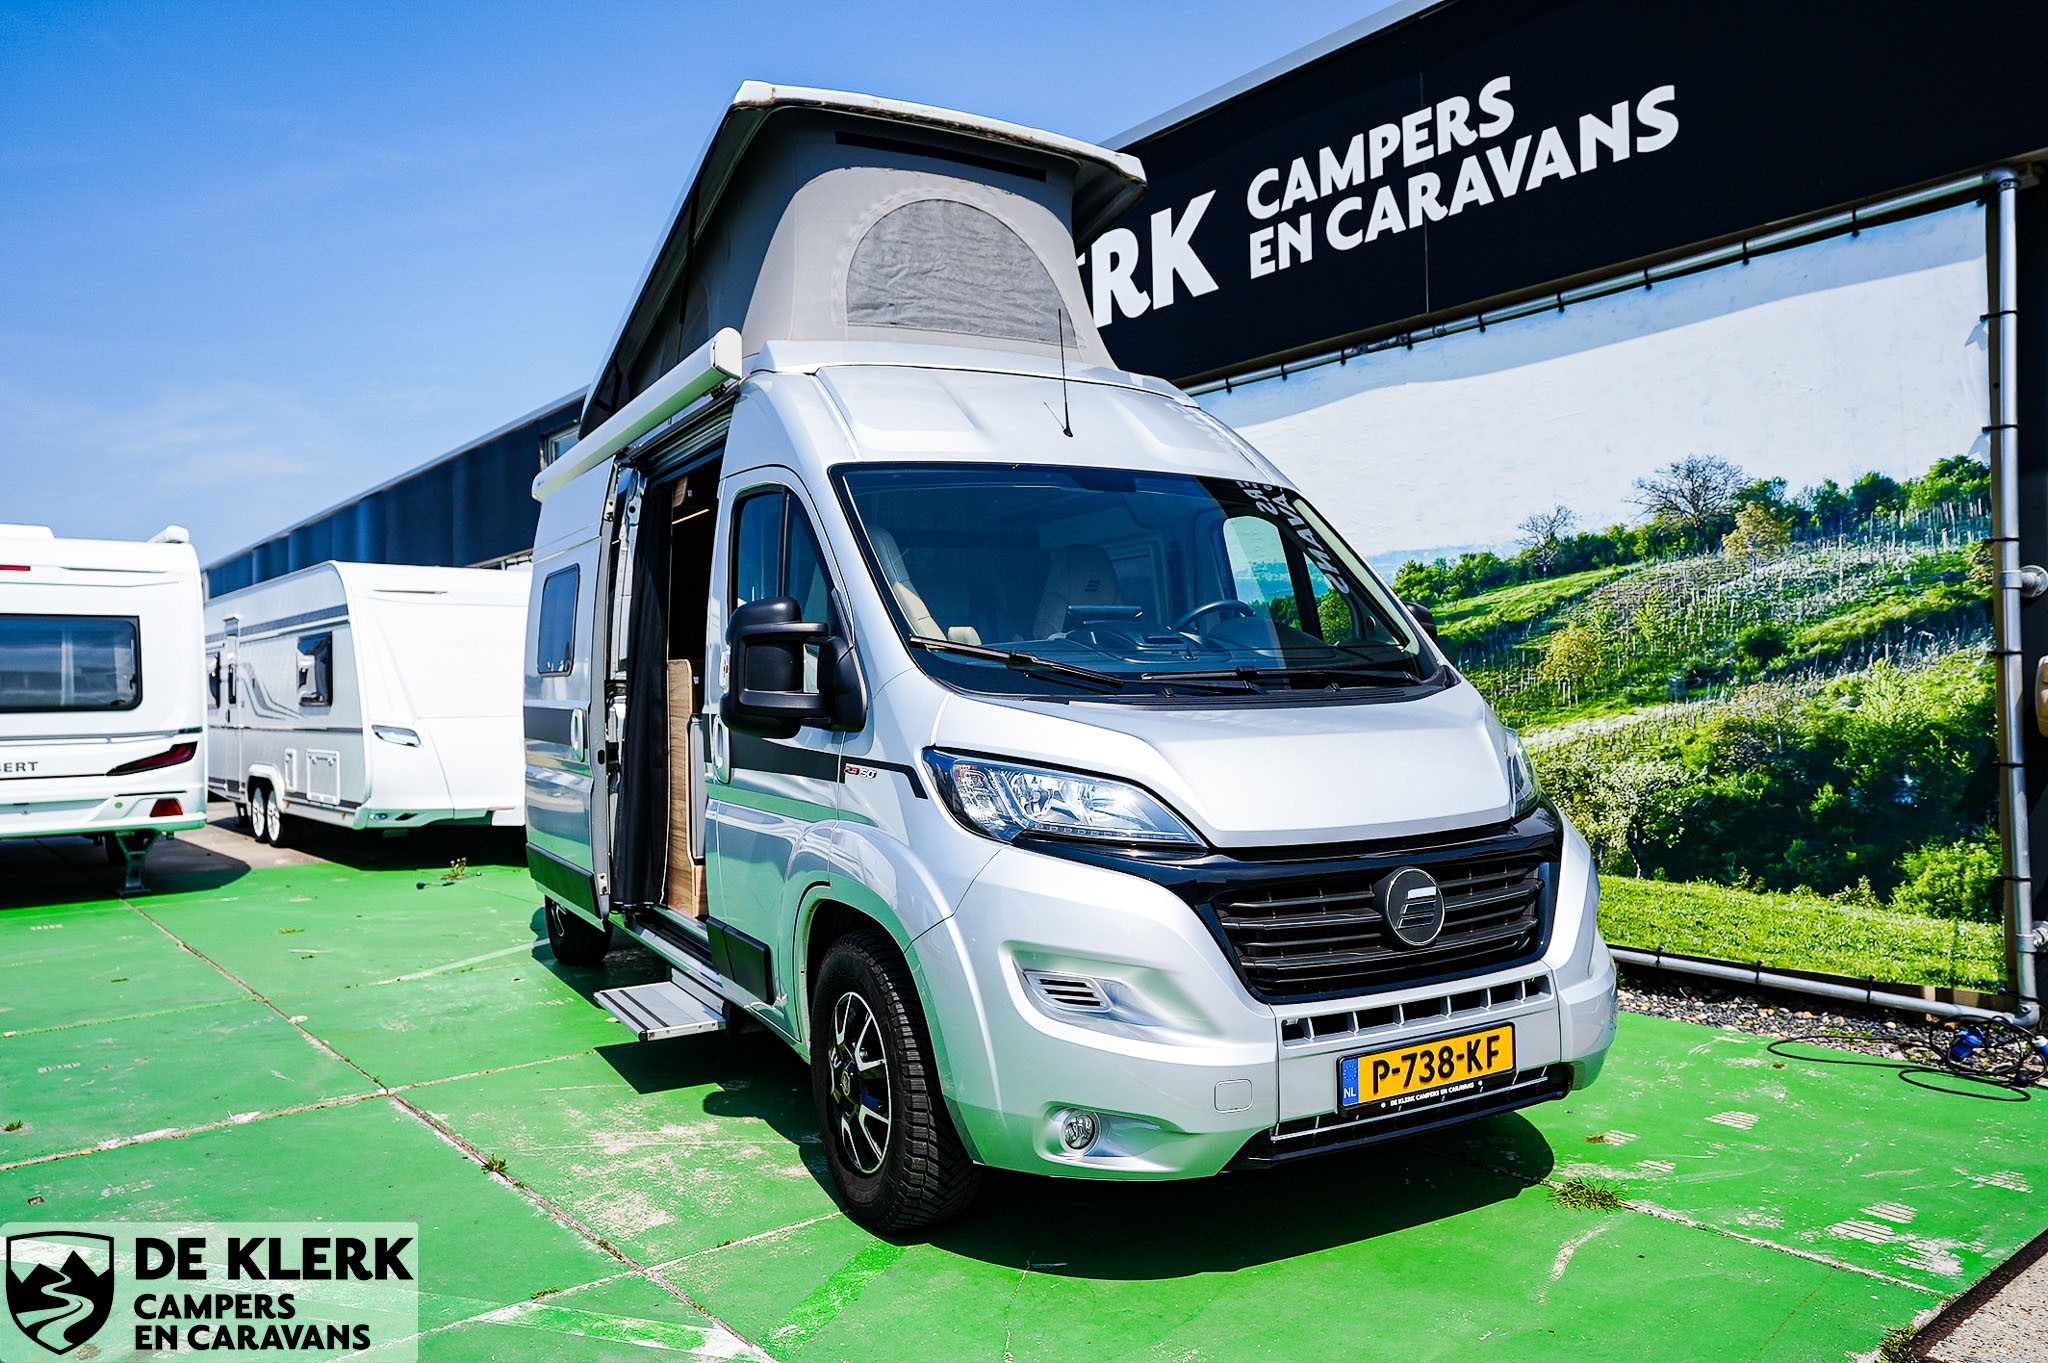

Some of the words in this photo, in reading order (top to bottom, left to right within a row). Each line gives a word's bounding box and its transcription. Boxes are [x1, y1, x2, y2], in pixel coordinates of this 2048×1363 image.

[1246, 75, 1515, 220] CAMPERS
[1249, 213, 1313, 279] EN
[1325, 84, 1680, 251] CARAVANS
[1076, 189, 1220, 328] RK
[0, 762, 39, 773] ERT
[1343, 1086, 1357, 1099] NL
[1372, 1034, 1501, 1095] P-738-KF
